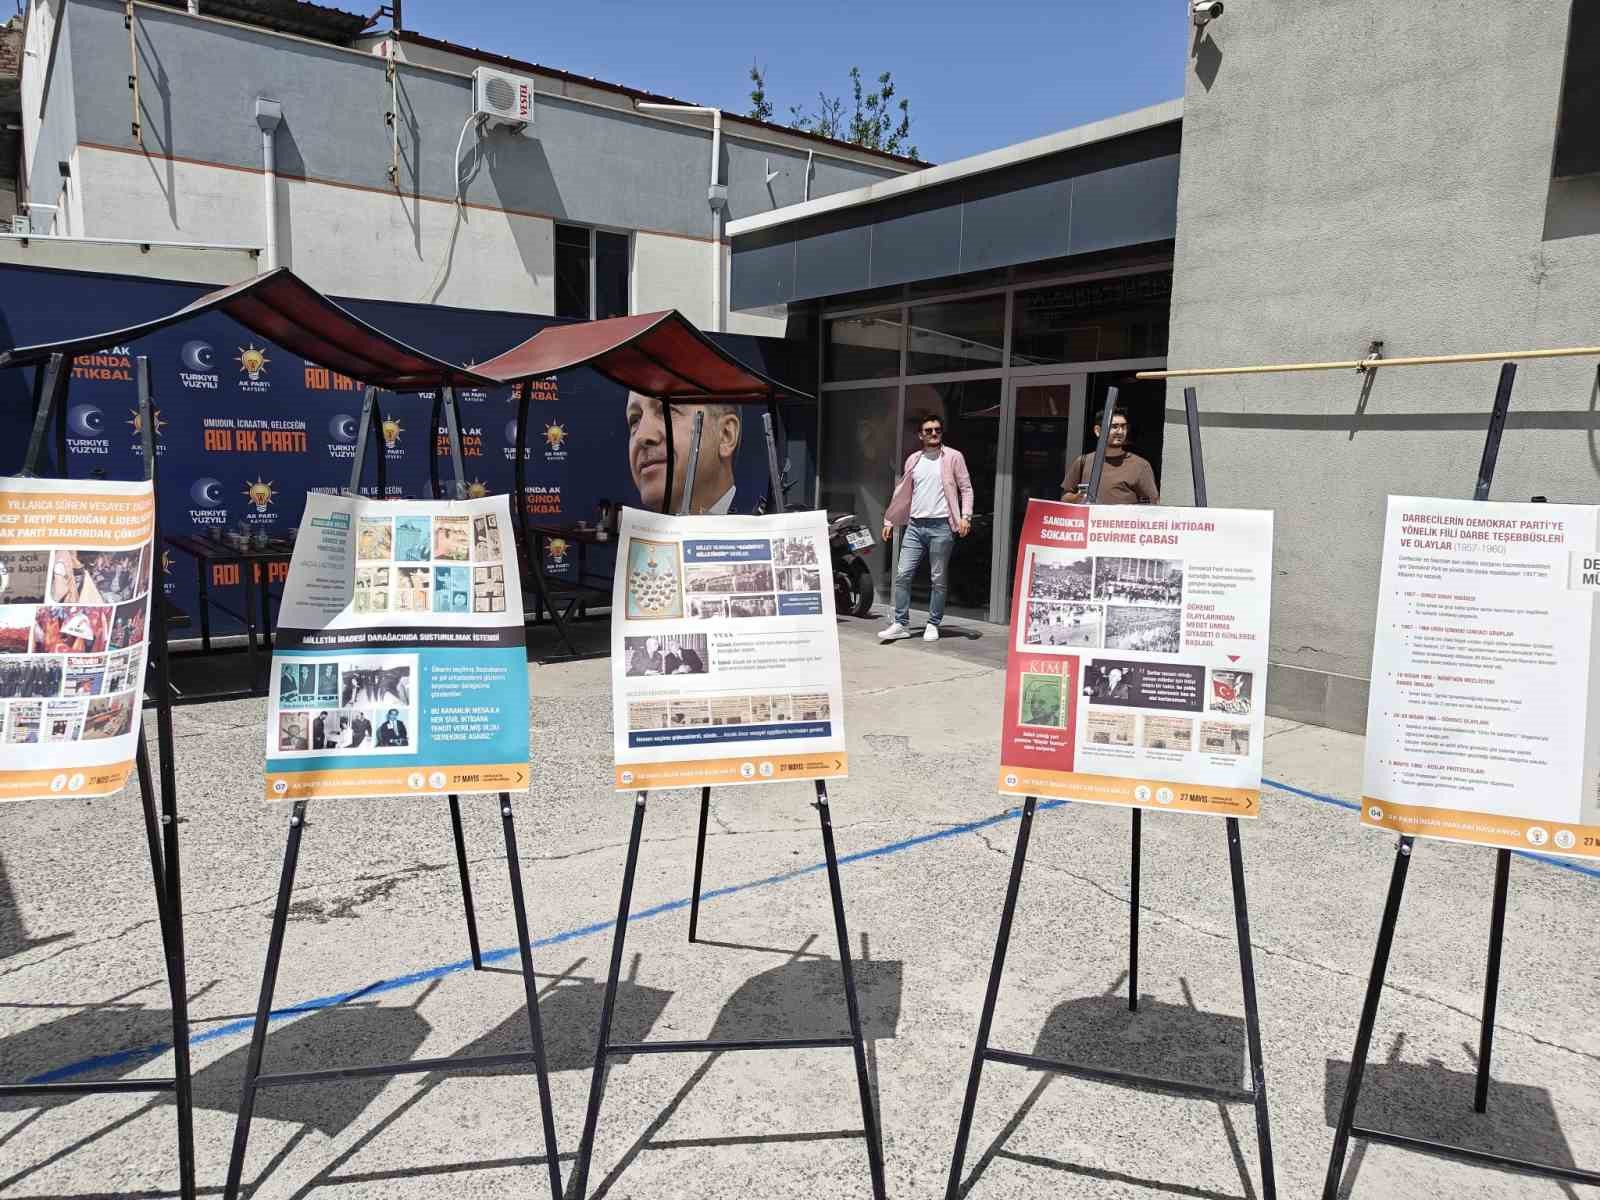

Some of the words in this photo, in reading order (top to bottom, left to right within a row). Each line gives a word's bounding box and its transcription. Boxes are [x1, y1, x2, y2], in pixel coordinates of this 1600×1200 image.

[520, 84, 528, 115] VESTEL
[113, 346, 130, 355] AK
[469, 428, 481, 436] AK
[204, 429, 231, 451] ADI
[236, 430, 257, 451] AK
[1090, 519, 1168, 530] YENEMEDİKLERİ
[1171, 520, 1215, 532] İKTİDARI
[1402, 513, 1464, 526] DARBECİLERİN
[1466, 518, 1517, 529] DEMOKRAT
[1089, 532, 1136, 543] DEVİRME
[1139, 534, 1178, 546] ÇABASI
[1460, 530, 1489, 541] DARBE
[1493, 532, 1564, 544] TEŞEBBÜSLERİ
[1401, 538, 1411, 548] VE
[1414, 539, 1452, 550] OLAYLAR
[419, 632, 471, 641] SUSTURULMAK
[1180, 793, 1188, 801] 27
[1584, 837, 1593, 846] 27
